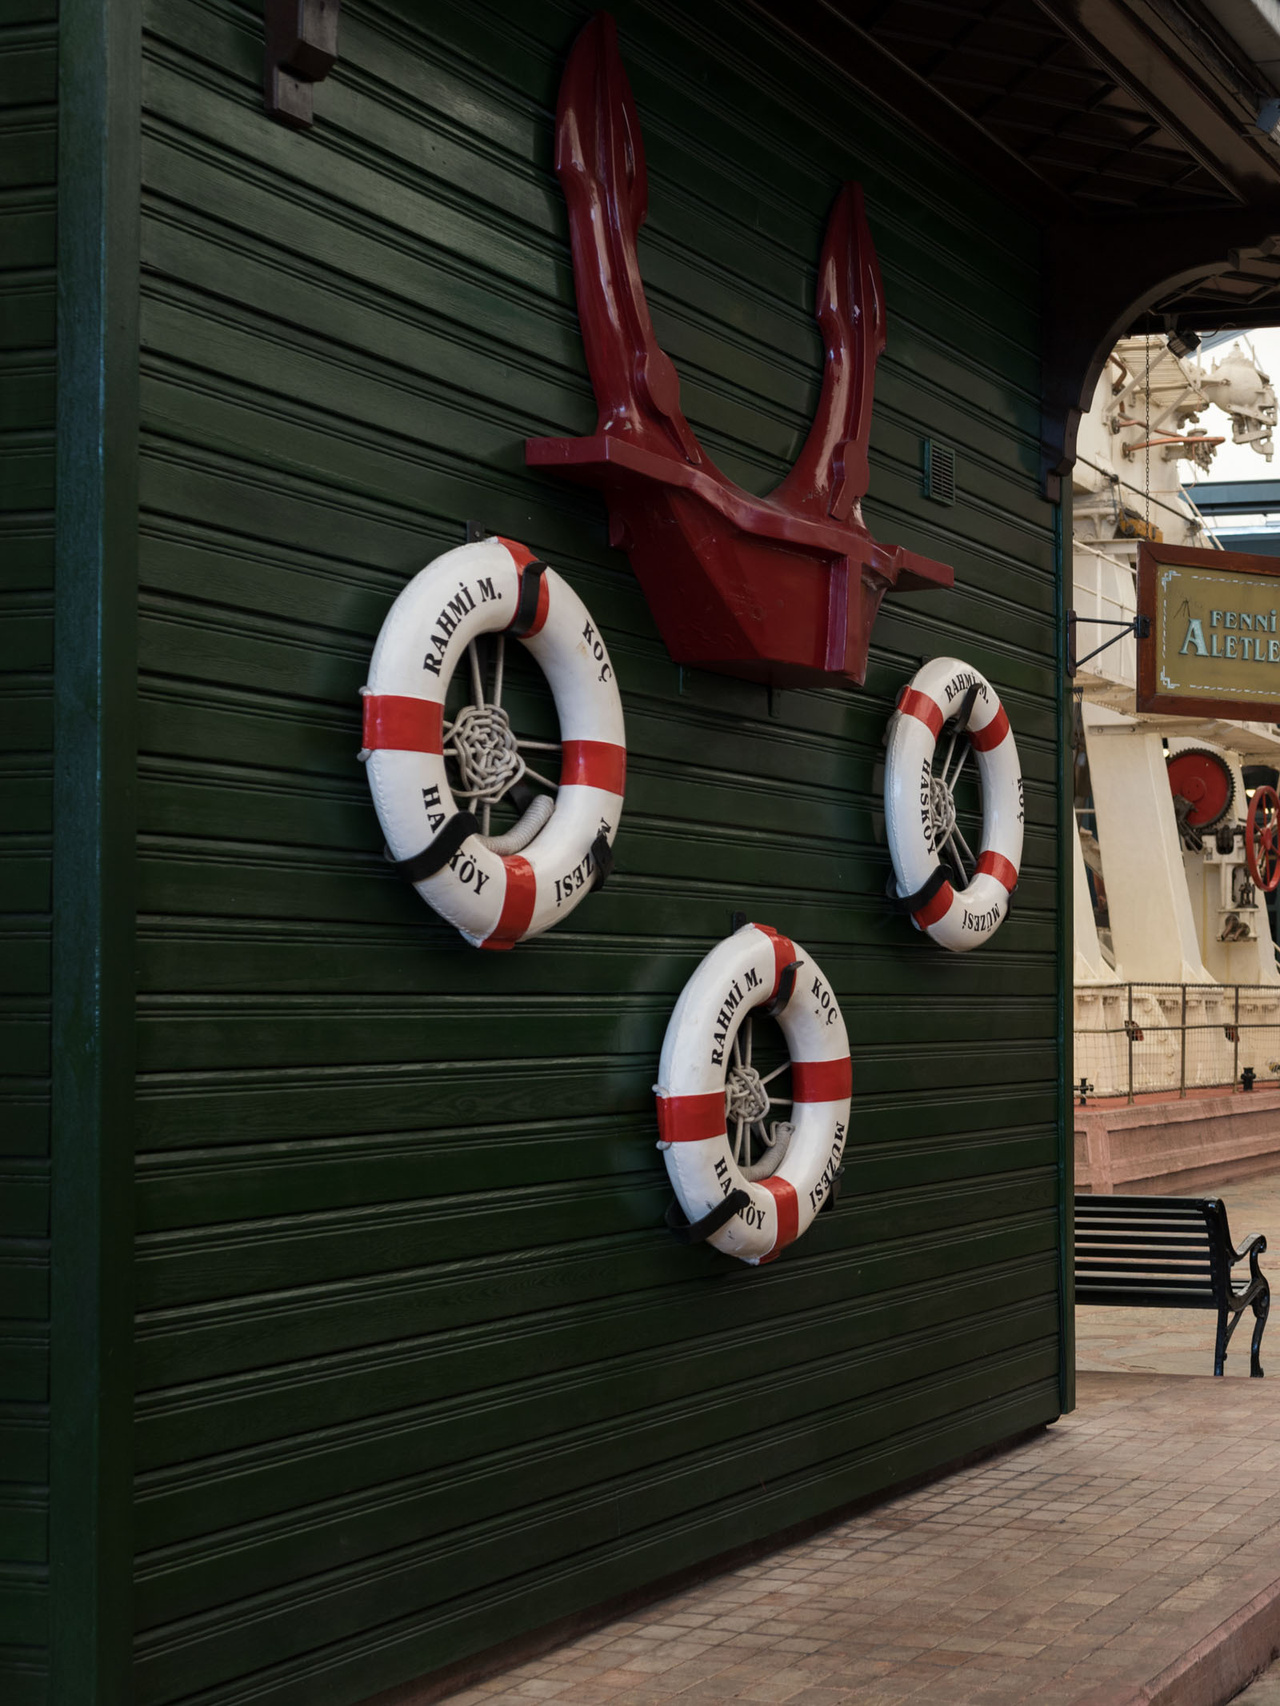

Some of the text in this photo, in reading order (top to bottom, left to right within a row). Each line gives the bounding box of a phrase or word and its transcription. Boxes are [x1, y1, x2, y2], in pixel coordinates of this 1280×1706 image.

[423, 577, 612, 907] RAHMİ M. KOÇ MZESİ
[422, 783, 490, 895] HAKÖY
[711, 980, 744, 1067] RAHMİ
[744, 967, 763, 992] M.
[811, 976, 838, 1026] KOÇ
